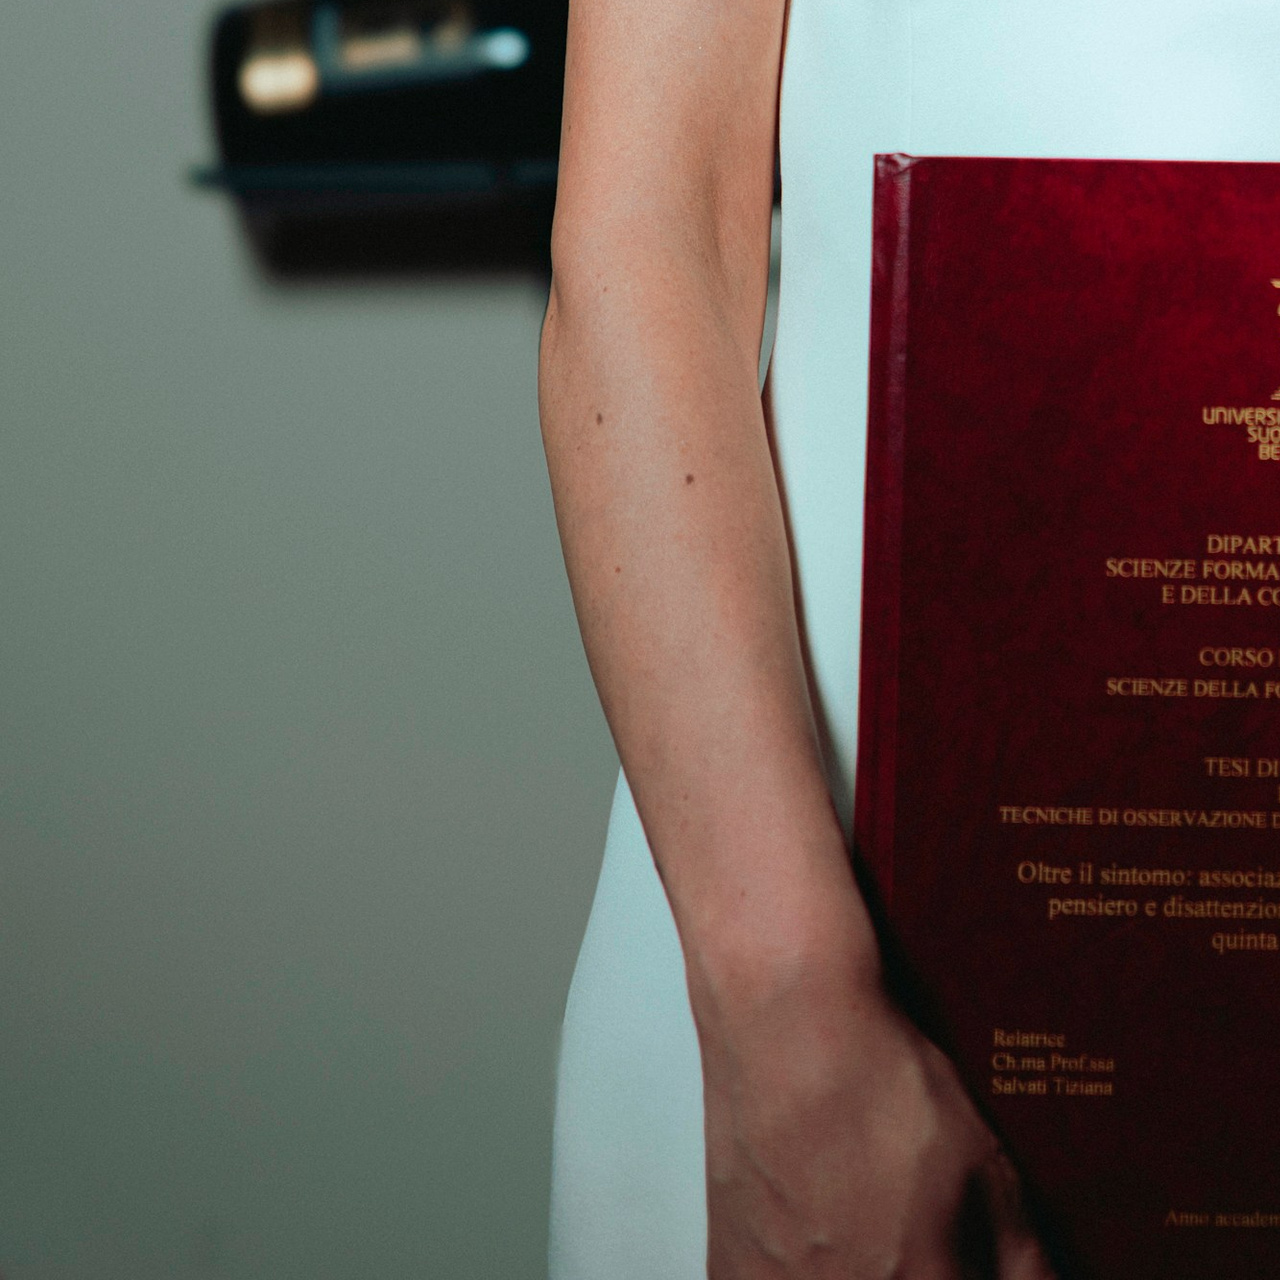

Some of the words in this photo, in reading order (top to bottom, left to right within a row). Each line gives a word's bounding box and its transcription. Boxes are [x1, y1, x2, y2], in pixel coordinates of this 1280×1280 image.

[1106, 558, 1195, 578] SCIENZE
[1162, 585, 1174, 603] E
[1181, 585, 1252, 605] DELLA
[1199, 647, 1274, 667] CORSO
[1107, 678, 1187, 696] SCIENZE
[1194, 680, 1258, 697] DELLA
[1205, 757, 1249, 776] TESI
[1257, 759, 1279, 777] DI
[1000, 806, 1093, 824] TECNICHE
[1099, 808, 1118, 825] DI
[1123, 809, 1266, 828] OSSERVAZIONE
[1017, 861, 1072, 884] Oltre
[1080, 863, 1092, 884] il
[1101, 864, 1191, 885] sintomo:
[1049, 896, 1138, 919] pensiero
[1145, 901, 1157, 917] e
[1212, 929, 1278, 954] quinta
[994, 1029, 1065, 1047] Relatrice
[992, 1077, 1047, 1094] Salvati
[1054, 1077, 1113, 1095] Tiziana
[1165, 1209, 1209, 1226] Anno
